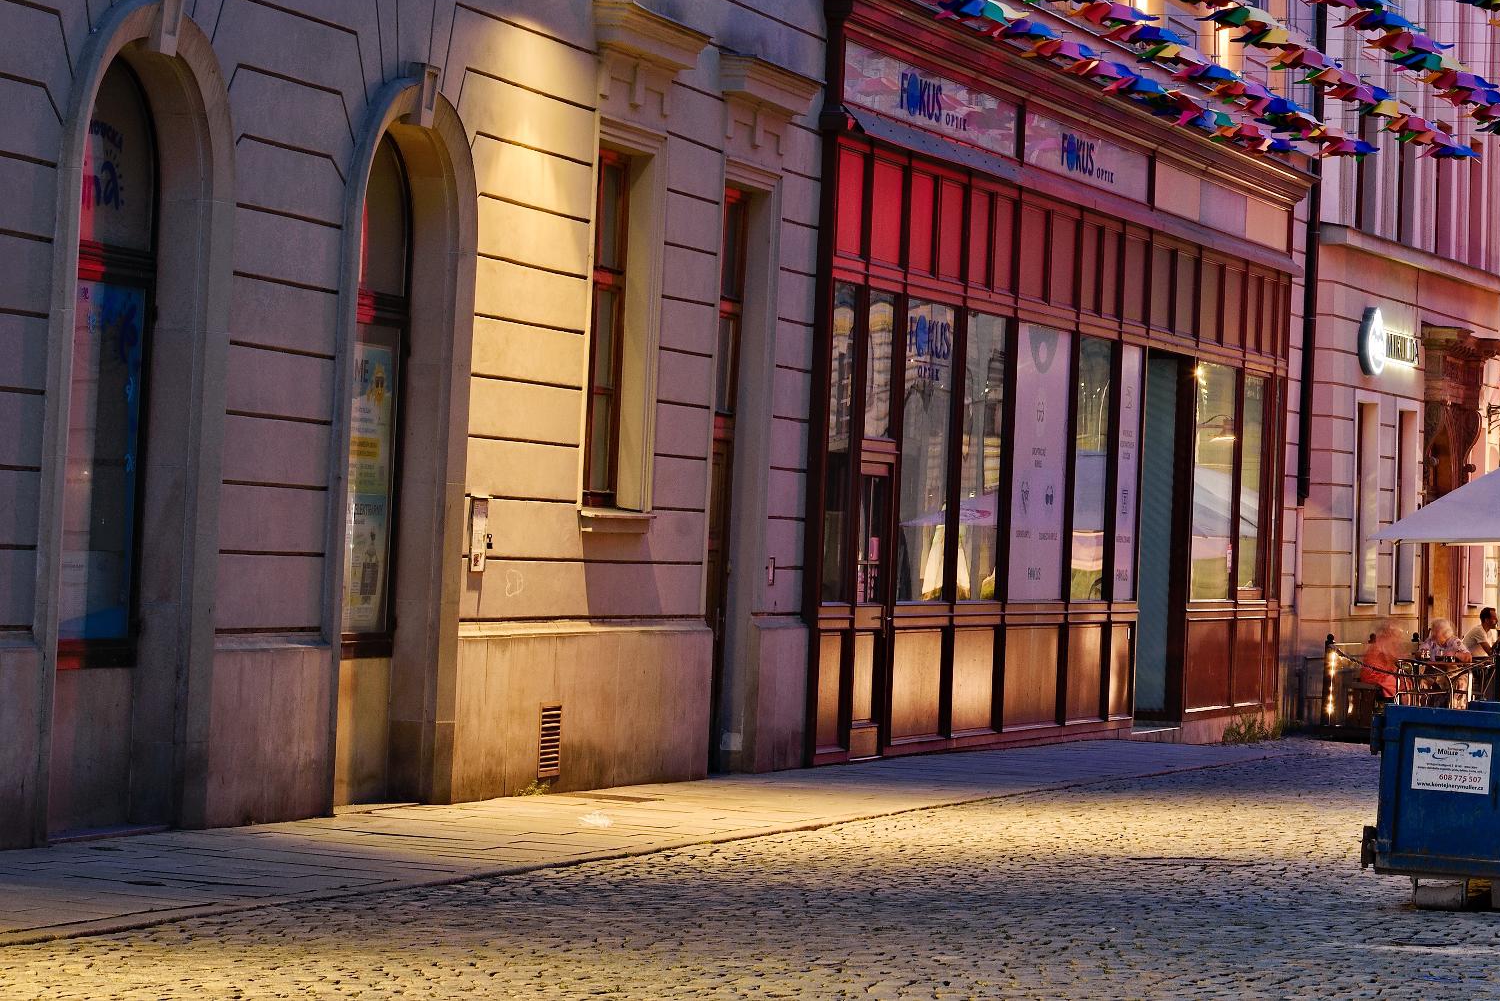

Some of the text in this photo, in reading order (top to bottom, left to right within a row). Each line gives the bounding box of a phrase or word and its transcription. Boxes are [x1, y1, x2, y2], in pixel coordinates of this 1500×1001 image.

[901, 72, 967, 131] FOKUS OPTIK
[1061, 132, 1114, 183] FOKUS OPTIK
[909, 314, 951, 360] FOKUS
[917, 364, 940, 382] OPTIK
